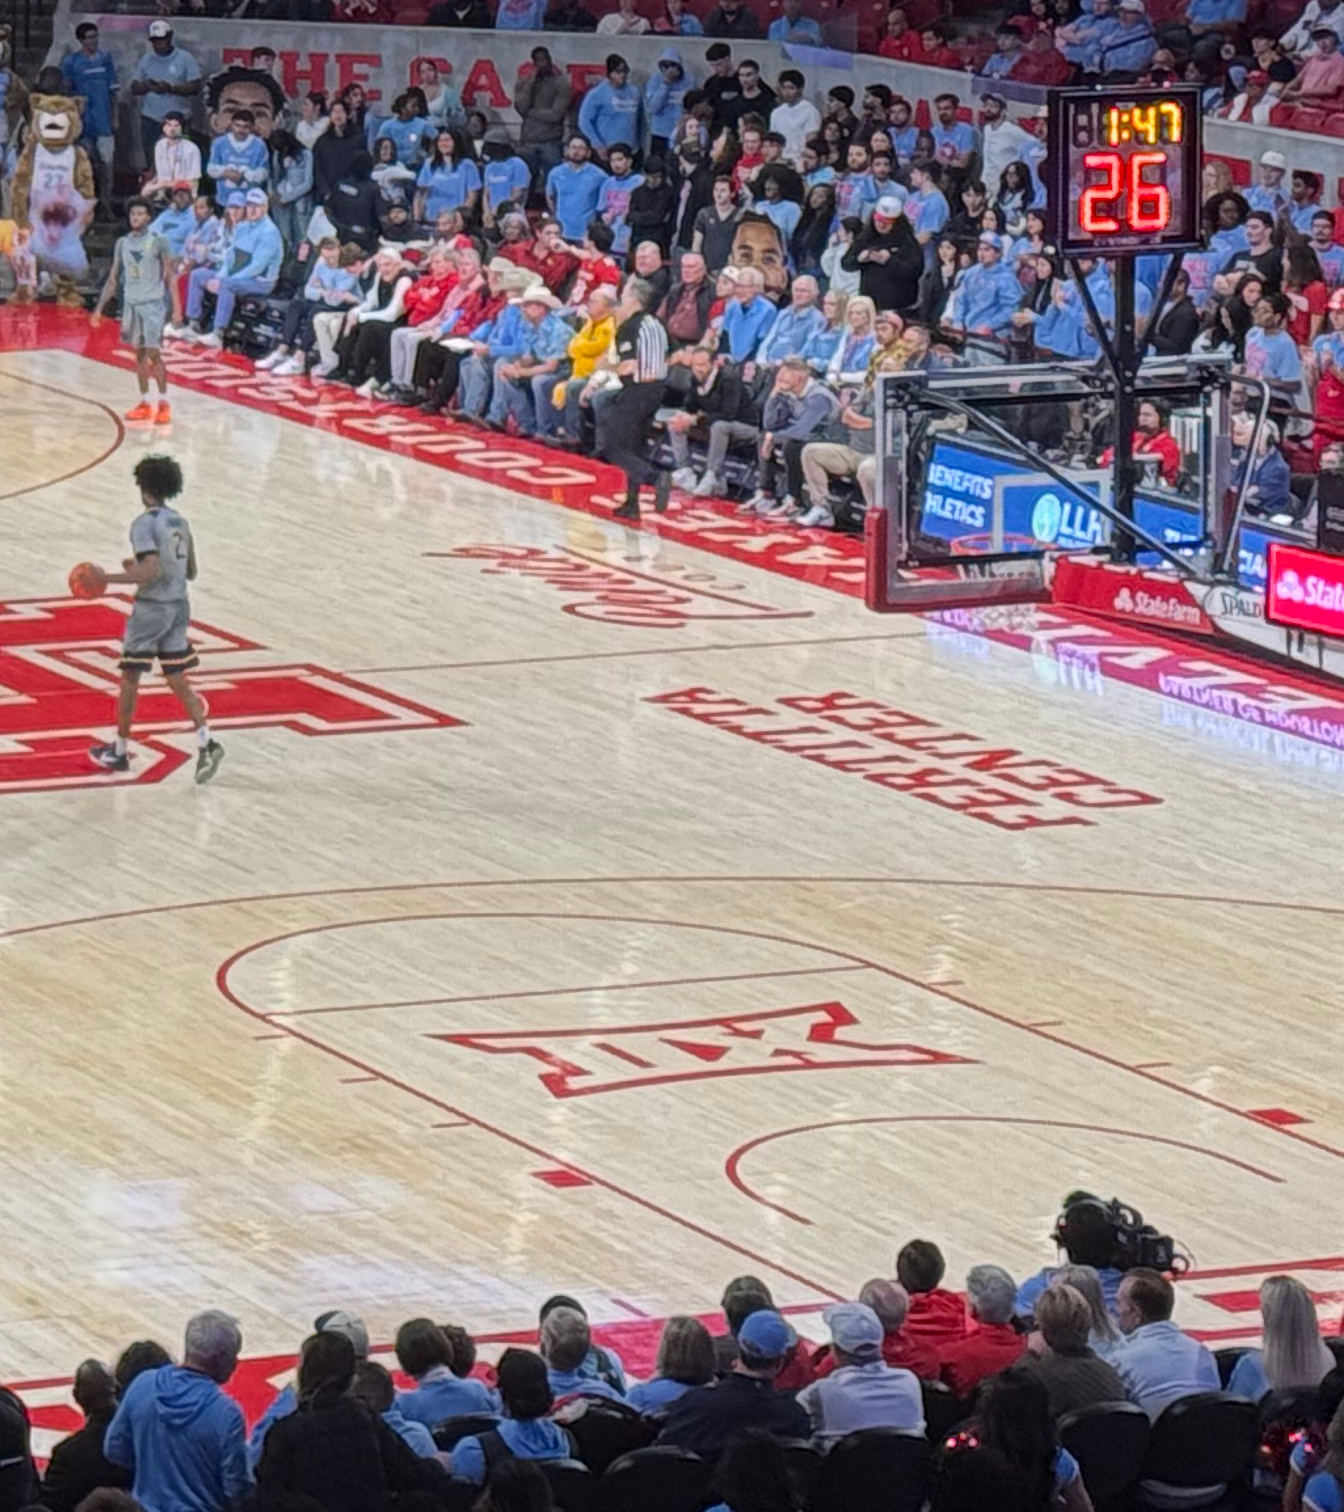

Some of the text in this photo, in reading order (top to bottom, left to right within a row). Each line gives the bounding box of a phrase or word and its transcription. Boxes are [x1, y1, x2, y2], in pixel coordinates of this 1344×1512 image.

[1110, 102, 1182, 146] 1:47
[1080, 152, 1170, 232] 26
[639, 686, 1099, 831] FERTITTA
[775, 690, 1165, 809] CENTER
